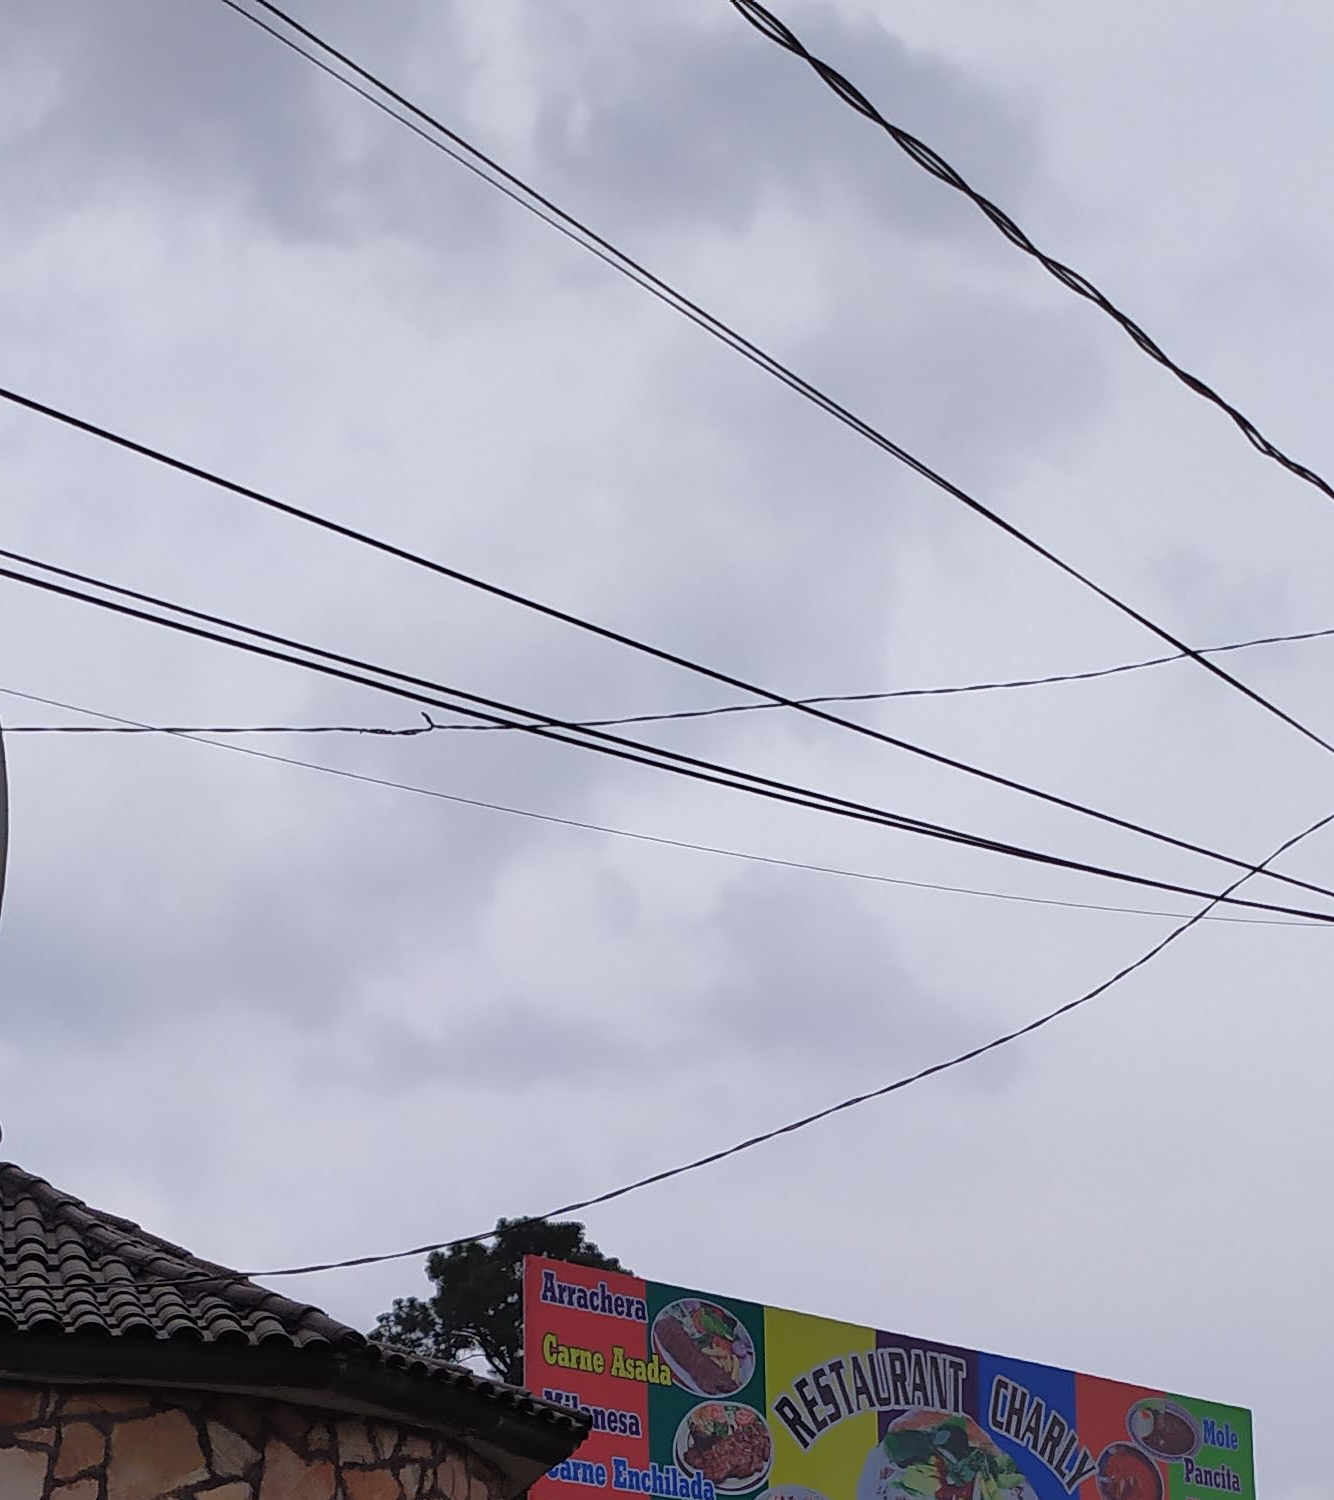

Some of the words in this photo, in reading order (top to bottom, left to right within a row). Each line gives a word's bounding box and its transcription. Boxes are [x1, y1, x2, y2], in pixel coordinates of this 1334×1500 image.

[541, 1270, 647, 1322] Arrachera
[542, 1334, 604, 1375] Carne
[610, 1347, 672, 1386] Asada
[773, 1348, 967, 1453] RESTAURANT
[989, 1374, 1097, 1494] CHARLY
[1202, 1418, 1238, 1450] Mole
[1183, 1456, 1241, 1492] Pancita
